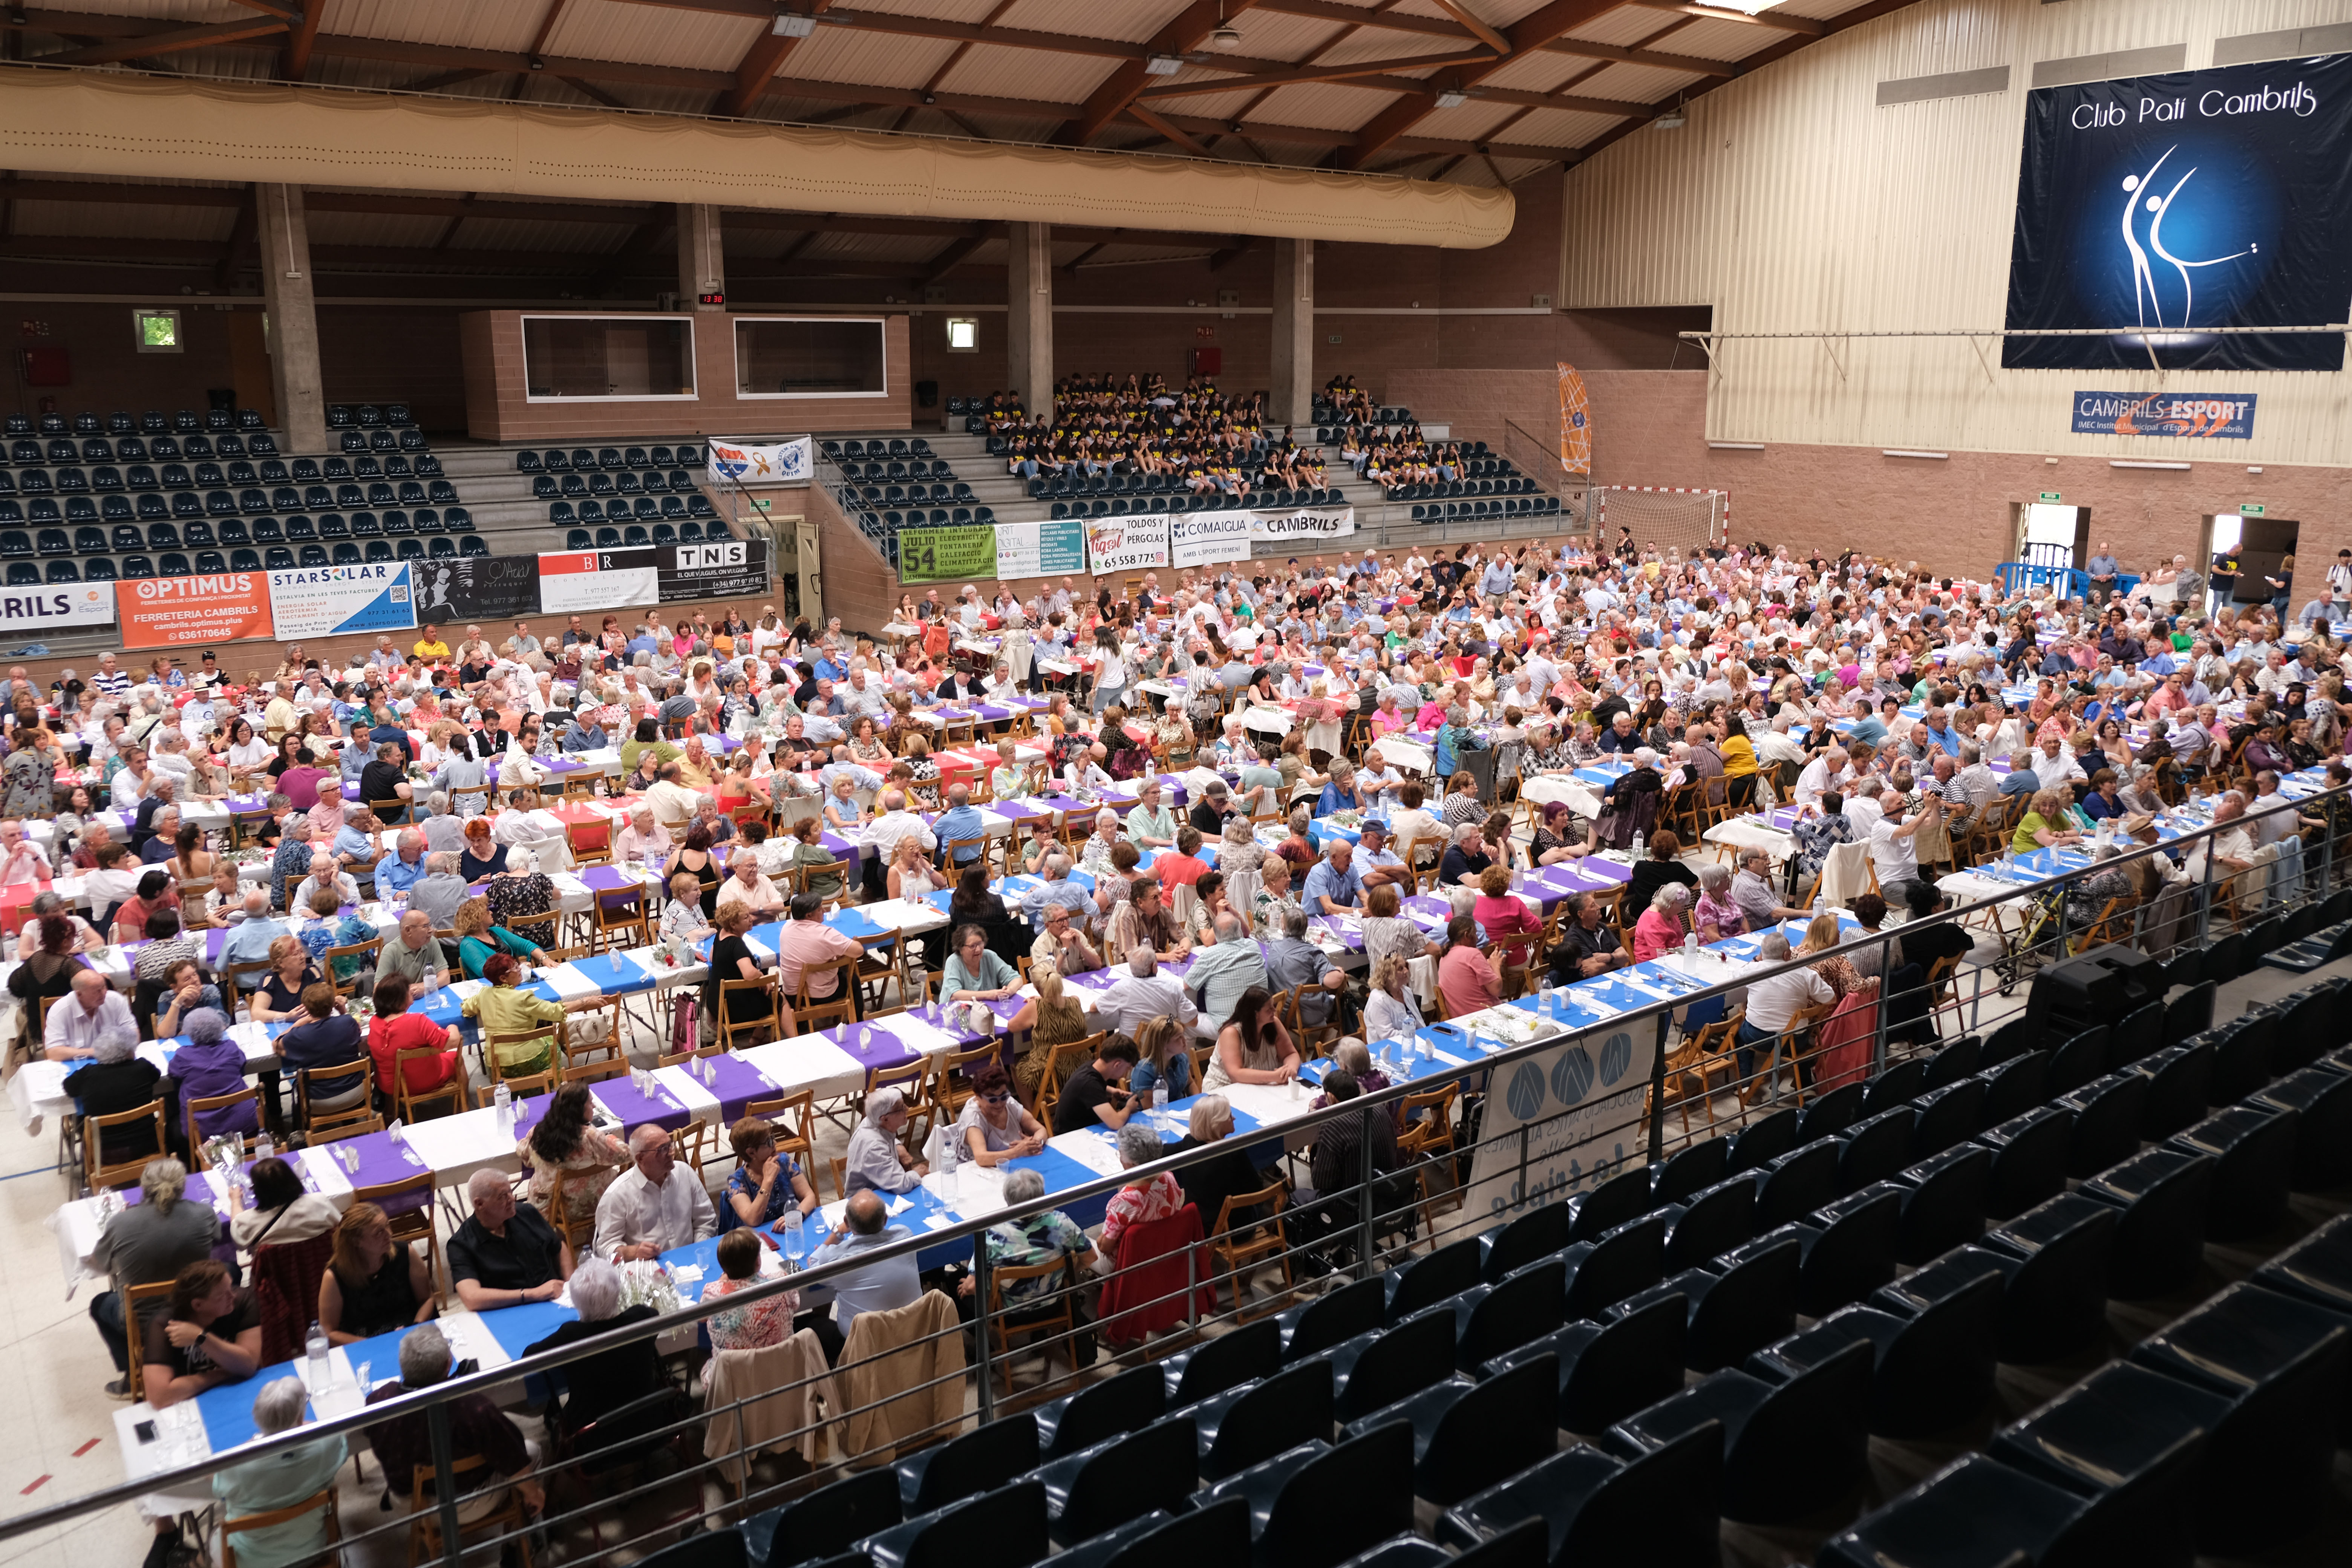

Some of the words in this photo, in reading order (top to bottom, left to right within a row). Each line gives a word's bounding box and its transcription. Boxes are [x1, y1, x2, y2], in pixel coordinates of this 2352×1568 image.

[2072, 101, 2125, 129] Club
[2139, 97, 2187, 123] Patí
[2200, 81, 2316, 117] Cambrils
[2080, 398, 2164, 418] CAMBRILS
[2170, 400, 2248, 420] ESPORT
[2123, 423, 2158, 431] Municipal
[2163, 423, 2197, 432] d'Esports
[2210, 425, 2243, 433] Cambrils
[997, 525, 1014, 536] CRIT
[1126, 519, 1156, 529] TOLDOS
[1159, 519, 1164, 527] Y
[1188, 520, 1246, 535] COMAIGUA
[1267, 517, 1339, 533] CAMBRILS
[903, 536, 935, 547] JULIO
[940, 533, 988, 542] ELECTRICITAT
[998, 536, 1025, 549] DIGITAL
[1127, 533, 1164, 545] PÉRGOLAS
[583, 557, 593, 570] B
[603, 555, 613, 568] R
[681, 547, 741, 565] TNS
[904, 547, 937, 573] 54
[1119, 555, 1136, 565] 558
[1138, 553, 1155, 563] 775
[2227, 561, 2237, 570] 70
[136, 574, 252, 599] OPTIMUS
[0, 594, 71, 618] RILS
[133, 610, 202, 623] FERRETERIA
[204, 605, 258, 617] CAMBRILS
[153, 617, 243, 630] cambrils.optimus.plus
[178, 628, 231, 639] 636170645
